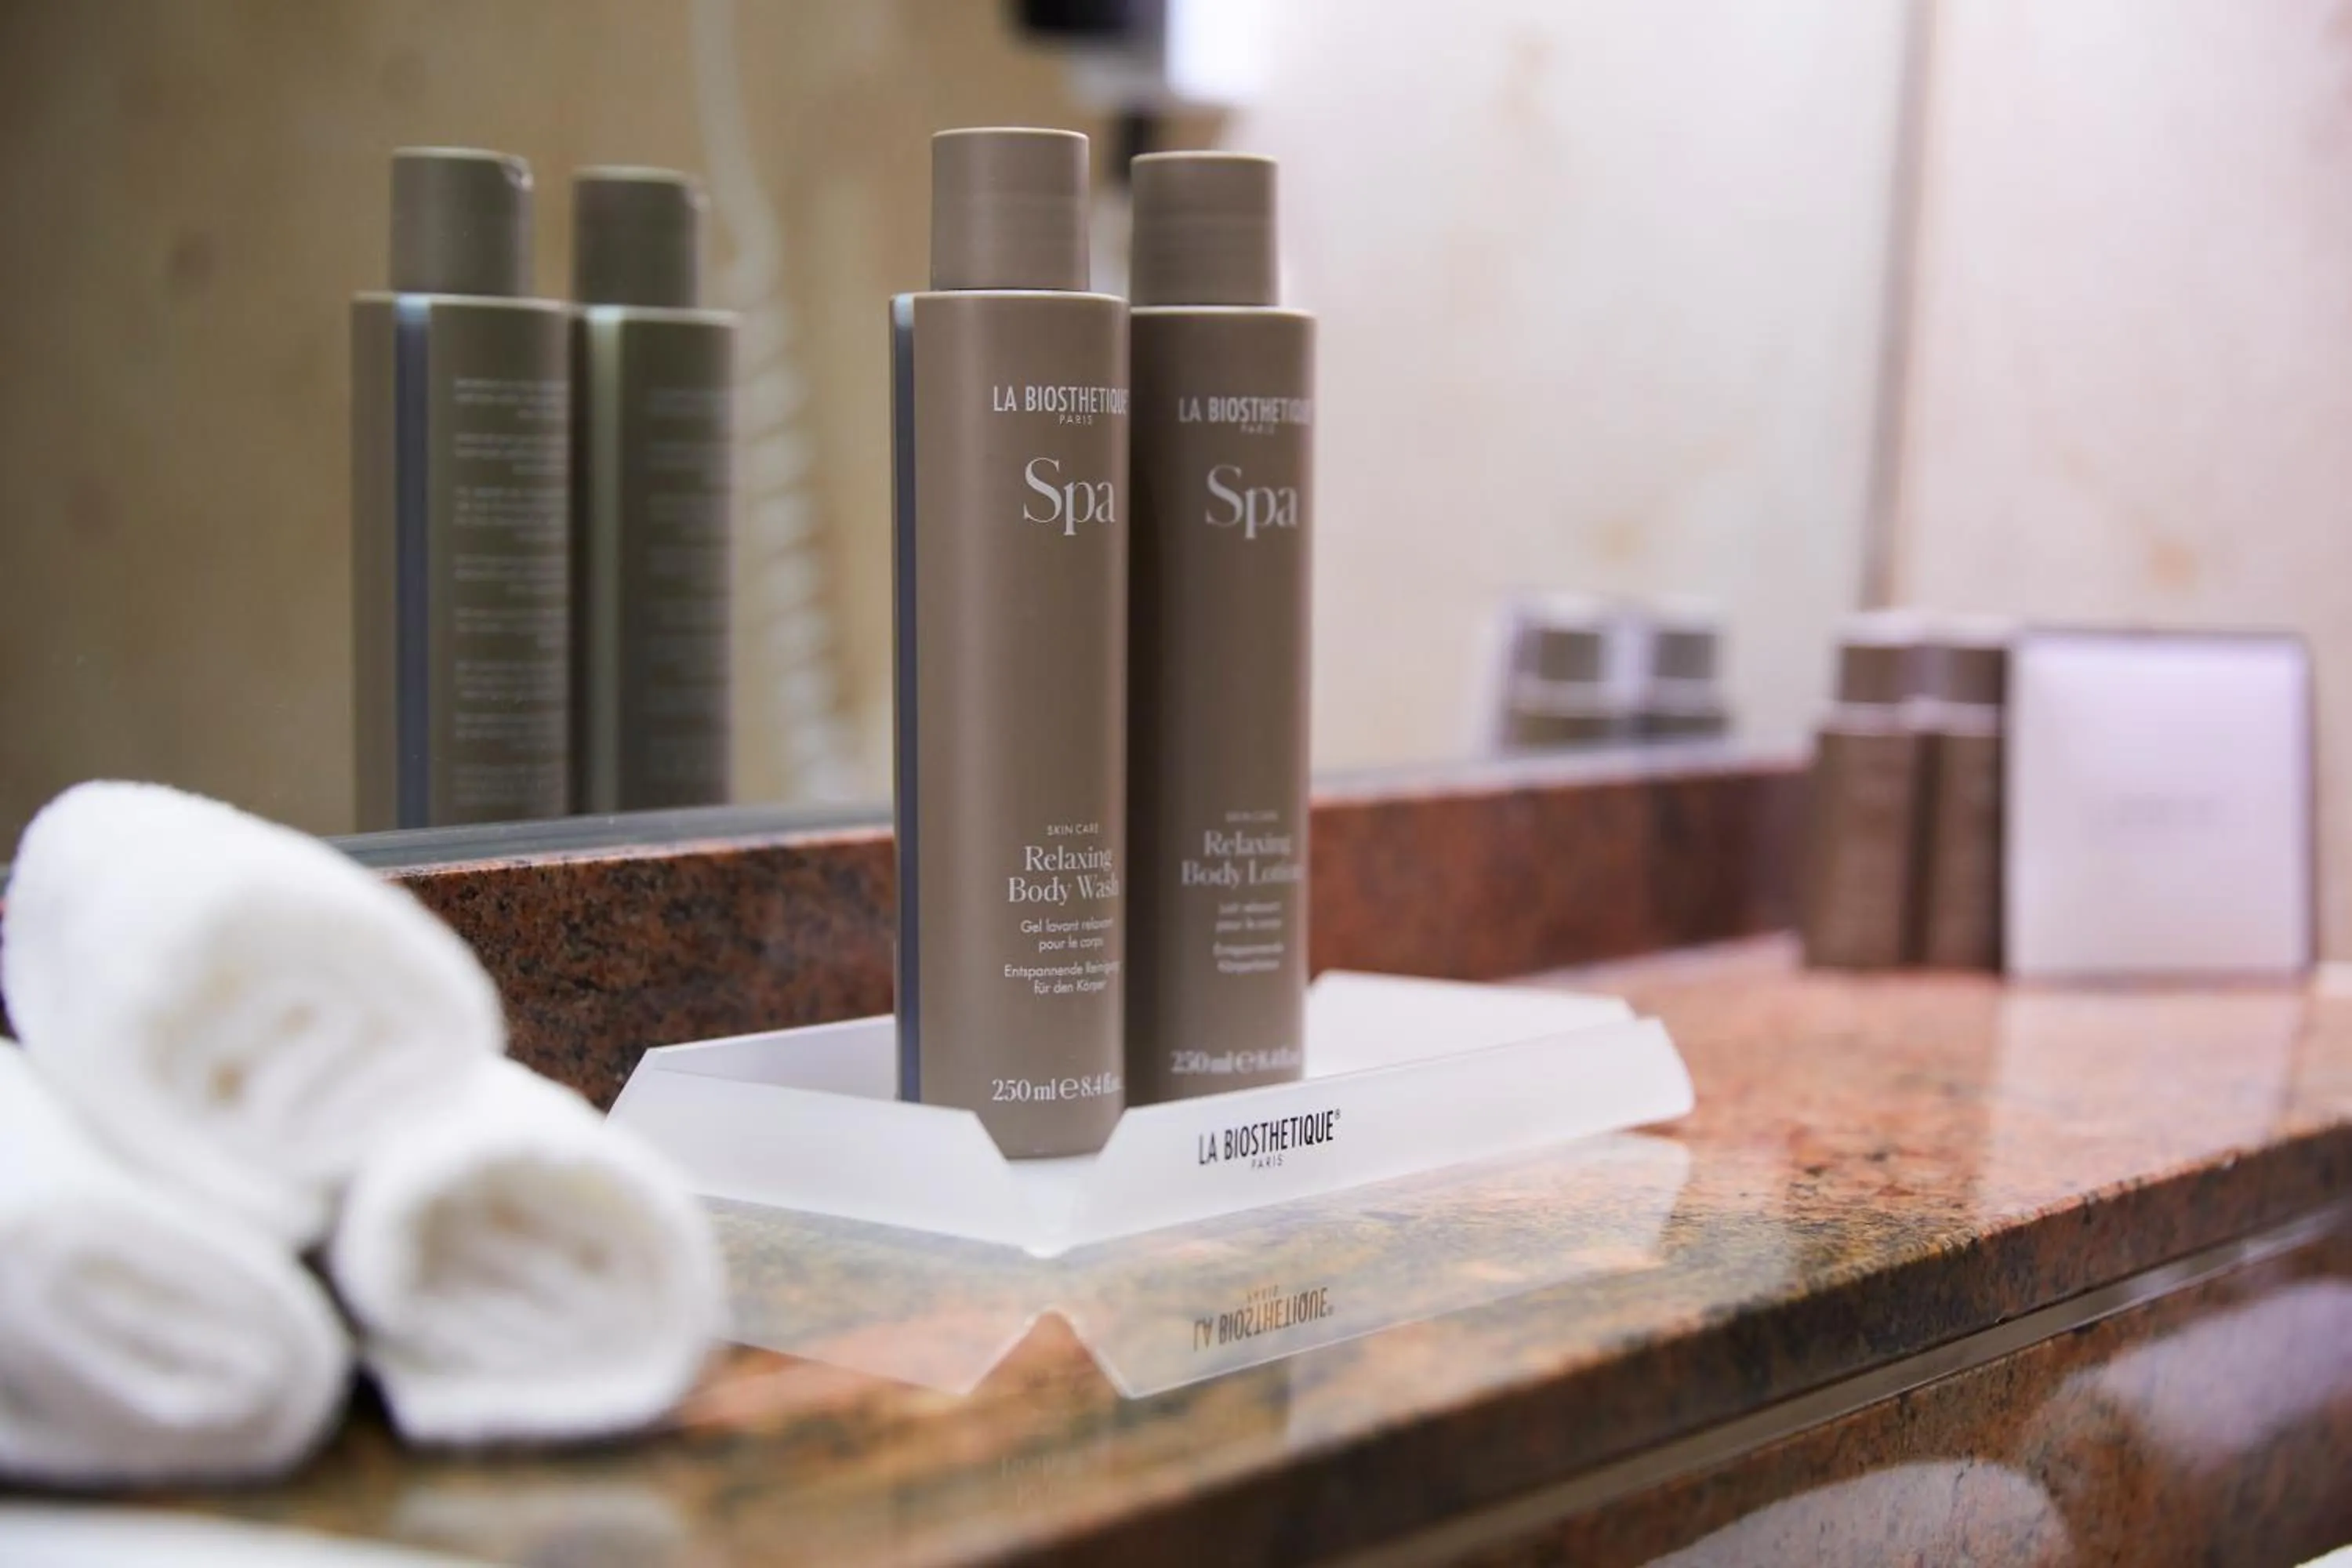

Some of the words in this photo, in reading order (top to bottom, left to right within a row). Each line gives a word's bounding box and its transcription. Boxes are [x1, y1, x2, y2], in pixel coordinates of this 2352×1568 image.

[993, 385, 1017, 412] LA
[1178, 396, 1202, 423] LA
[1059, 414, 1092, 426] PARIS
[1023, 456, 1116, 535] Spa
[1205, 464, 1298, 539] Spa
[1047, 824, 1073, 837] SKIN
[1024, 844, 1112, 872] Relaxing
[1181, 859, 1241, 889] Body
[1008, 876, 1072, 906] Body
[1076, 872, 1120, 900] Wash
[1020, 918, 1042, 933] Gel
[1045, 917, 1079, 933] lavant
[1039, 940, 1065, 953] pour
[1068, 934, 1078, 948] le
[1004, 961, 1083, 981] Entspannende
[1034, 979, 1052, 995] für
[1053, 979, 1073, 994] den
[1169, 1049, 1210, 1075] 250
[991, 1077, 1031, 1102] 250
[1033, 1078, 1056, 1101] ml
[1198, 1131, 1218, 1166] LA
[1250, 1153, 1284, 1169] PARIS
